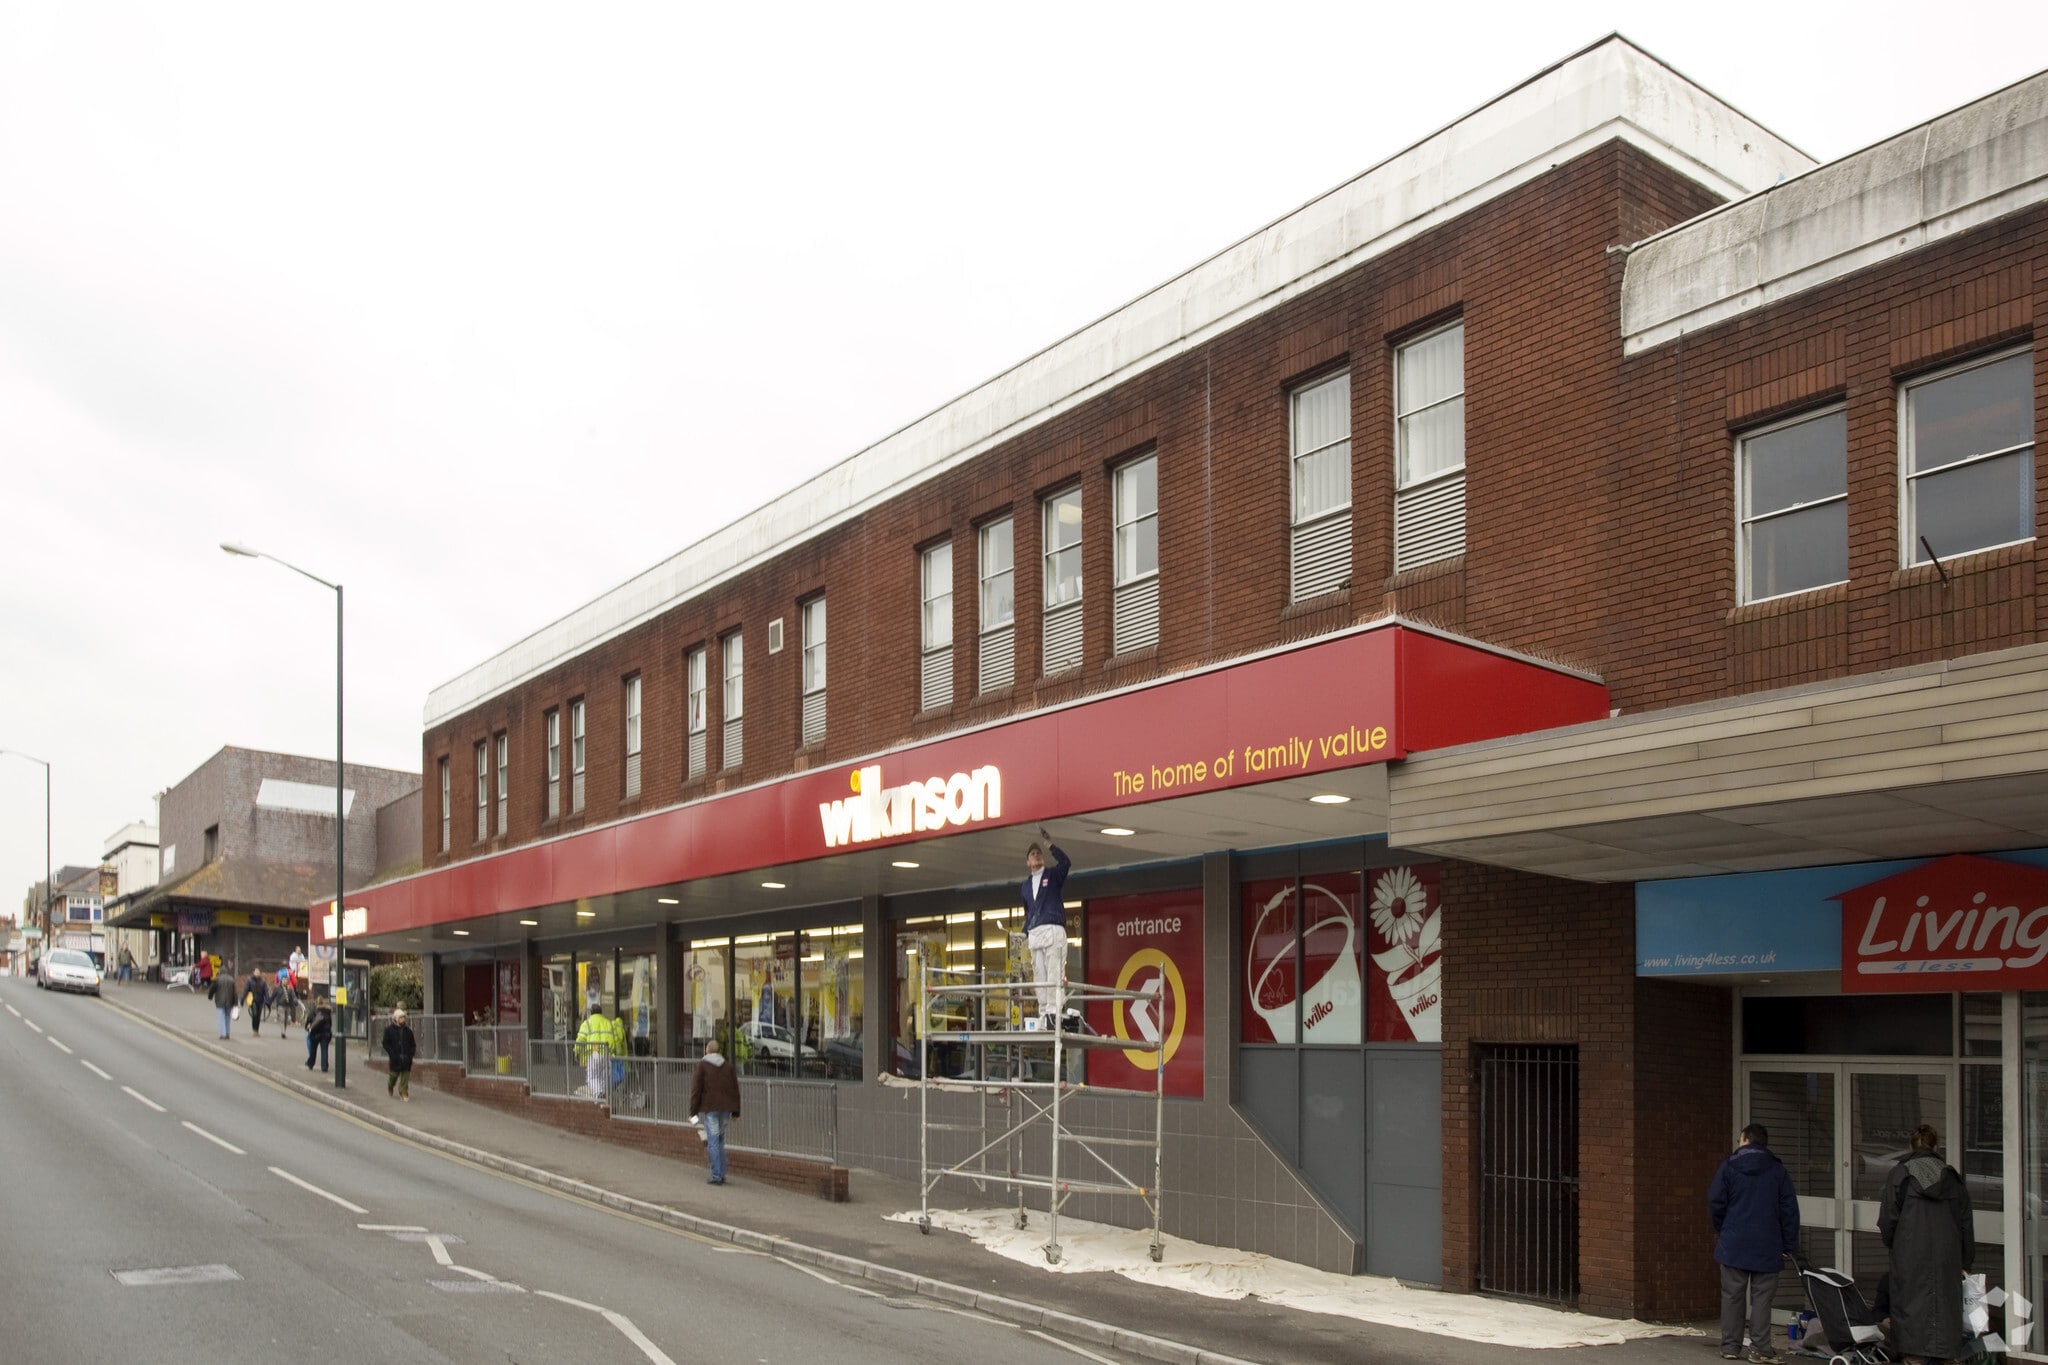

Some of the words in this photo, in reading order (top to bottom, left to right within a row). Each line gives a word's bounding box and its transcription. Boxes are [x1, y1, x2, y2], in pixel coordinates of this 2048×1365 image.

[1113, 770, 1145, 797] The
[1151, 760, 1208, 791] home
[1213, 749, 1236, 777] of
[1244, 736, 1313, 769] family
[1319, 725, 1388, 759] value
[819, 765, 1001, 848] wilkinson
[1116, 916, 1182, 937] entrance
[1893, 961, 1908, 973] 4
[1918, 960, 1975, 972] less
[1303, 1000, 1334, 1030] wilko
[1409, 993, 1438, 1018] wilko
